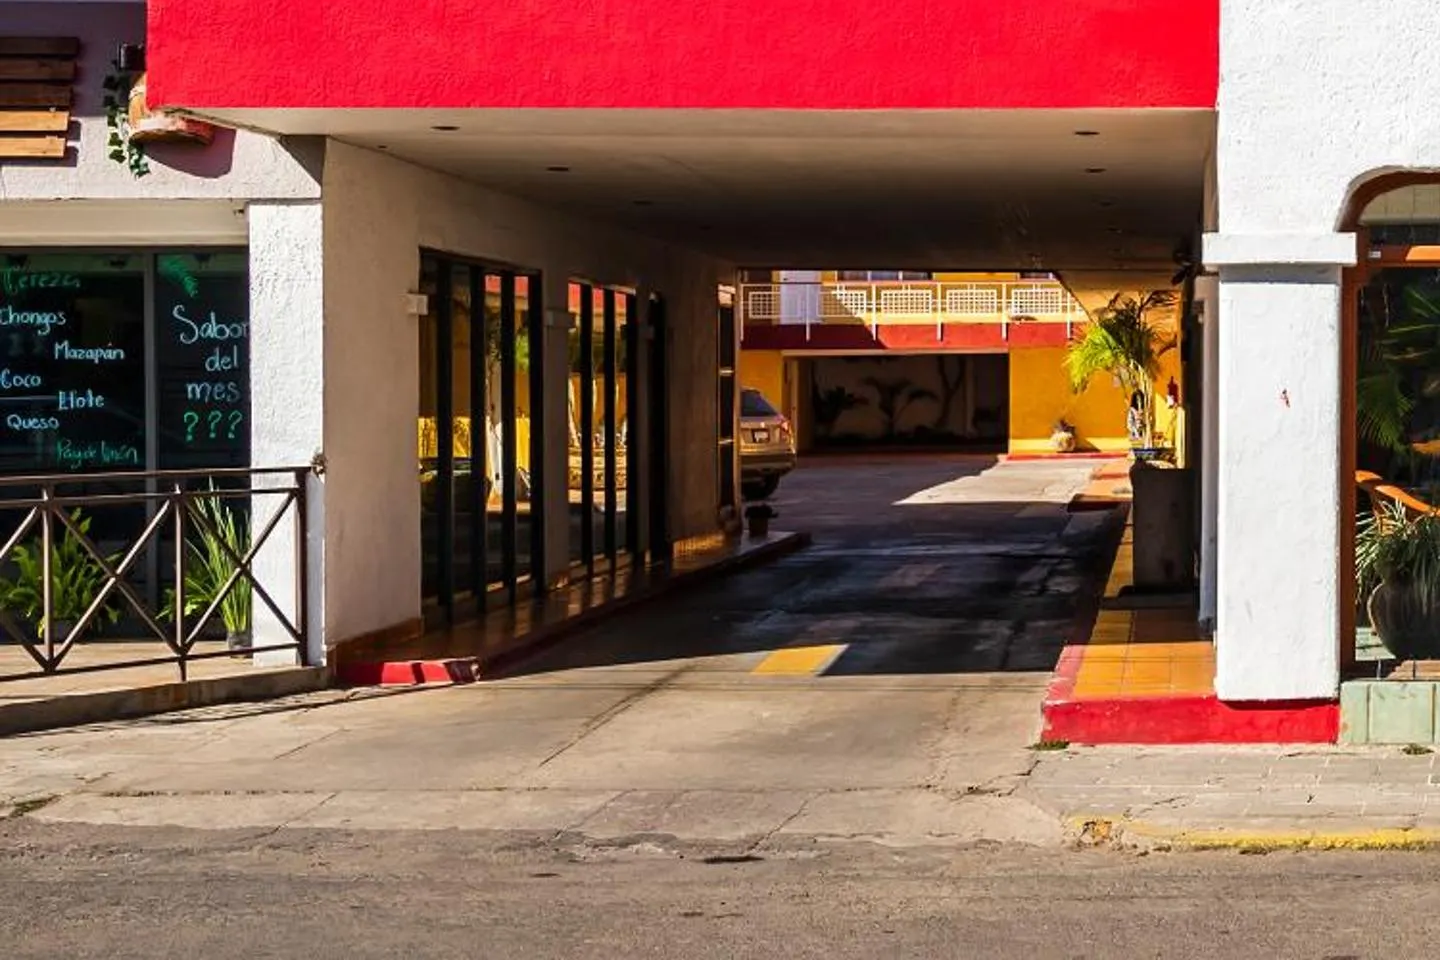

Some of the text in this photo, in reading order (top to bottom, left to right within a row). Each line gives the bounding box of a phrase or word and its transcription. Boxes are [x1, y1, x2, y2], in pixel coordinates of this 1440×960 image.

[172, 304, 249, 344] Sabor
[205, 345, 239, 372] del
[0, 368, 41, 389] Coco
[187, 381, 240, 402] mes
[6, 414, 60, 431] Queso
